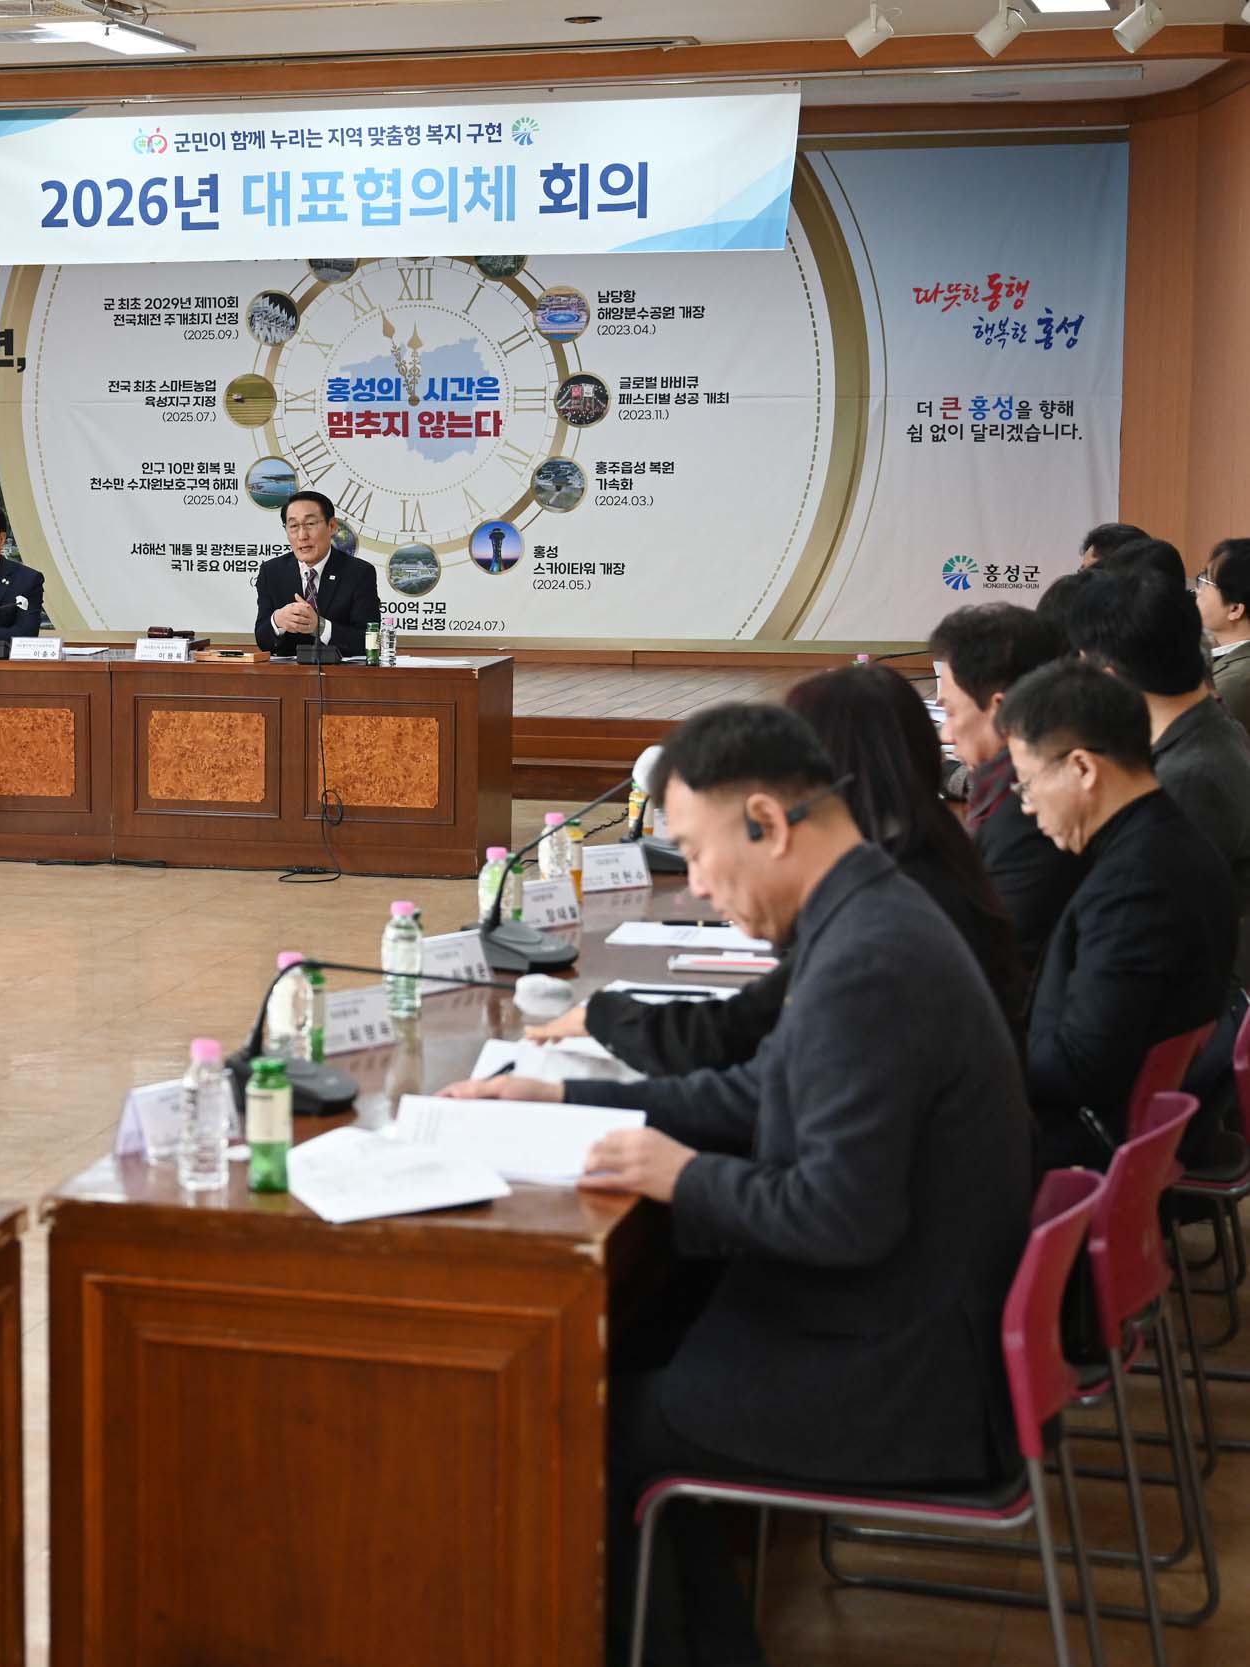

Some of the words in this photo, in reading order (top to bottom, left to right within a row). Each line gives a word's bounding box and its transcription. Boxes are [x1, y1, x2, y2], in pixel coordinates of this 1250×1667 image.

[174, 132, 226, 152] 군민이
[232, 131, 265, 150] 함께
[270, 128, 322, 149] 누리는
[328, 127, 363, 147] 지역
[368, 125, 421, 146] 맞춤형
[426, 124, 462, 144] 복지
[466, 122, 503, 143] 구현
[40, 173, 219, 231] 2026년
[243, 165, 516, 227] 대표협의체
[539, 162, 648, 220] 회의
[398, 268, 433, 300] XII
[462, 283, 485, 315] I
[597, 290, 636, 304] 남당항
[912, 283, 979, 313] 따뜻한
[981, 273, 1030, 313] 동행
[103, 298, 115, 311] 군
[117, 297, 141, 311] 최초
[144, 297, 191, 311] 2029년
[194, 296, 239, 310] 제110회
[340, 281, 377, 320] XI
[113, 313, 161, 326] 전국체전
[164, 312, 212, 326] 주개최지
[215, 312, 239, 325] 선정
[597, 306, 675, 320] 해양분수공원
[679, 305, 705, 319] 개장
[183, 329, 239, 341] (2025.09.)
[597, 324, 656, 336] (2023.04.)
[972, 316, 1027, 350] 행복한
[1034, 307, 1085, 350] 홍성
[498, 326, 534, 357] II
[108, 380, 131, 393] 전국
[133, 380, 156, 393] 최초
[158, 379, 216, 393] 스마트농업
[326, 376, 401, 402] 홍성의
[423, 376, 500, 402] 시간은
[619, 376, 657, 389] 글로벌
[660, 376, 699, 389] 바비큐
[145, 396, 190, 408] 육성지구
[192, 396, 216, 408] 지정
[514, 386, 546, 413] III
[618, 392, 671, 405] 페스티벌
[674, 392, 699, 405] 성공
[703, 392, 730, 405] 개최
[618, 409, 670, 421] (2023.11.)
[917, 400, 933, 418] 더
[939, 397, 962, 420] 큰
[968, 395, 1033, 421] 홍성을
[1038, 400, 1074, 420] 향해
[162, 411, 216, 423] (2025.07.)
[327, 411, 409, 438] 멈추지
[417, 410, 503, 438] 않는다
[906, 423, 923, 443] 쉼
[930, 423, 964, 443] 없이
[970, 423, 1083, 443] 달리겠습니다.
[141, 462, 165, 475] 인구
[168, 462, 194, 475] 10만
[196, 462, 220, 475] 회복
[223, 462, 236, 475] 및
[595, 461, 646, 475] 홍주읍성
[649, 461, 675, 475] 복원
[90, 478, 124, 491] 천수만
[127, 478, 211, 491] 수자원보호구역
[213, 478, 239, 491] 해제
[596, 478, 633, 491] 가속화
[183, 494, 239, 506] (2025.04.)
[462, 486, 485, 519] V
[595, 495, 654, 507] (2024.03.)
[130, 544, 166, 556] 서해선
[169, 544, 194, 556] 개통
[196, 544, 208, 556] 및
[533, 545, 559, 559] 홍성
[171, 560, 194, 572] 국가
[196, 560, 220, 572] 중요
[533, 562, 596, 576] 스카이타워
[600, 562, 625, 576] 개장
[983, 563, 1041, 583] 홍성군
[532, 579, 591, 591] (2024.05.)
[422, 602, 446, 614] 규모
[421, 617, 446, 631] 선정
[448, 620, 505, 632] (2024.07.)
